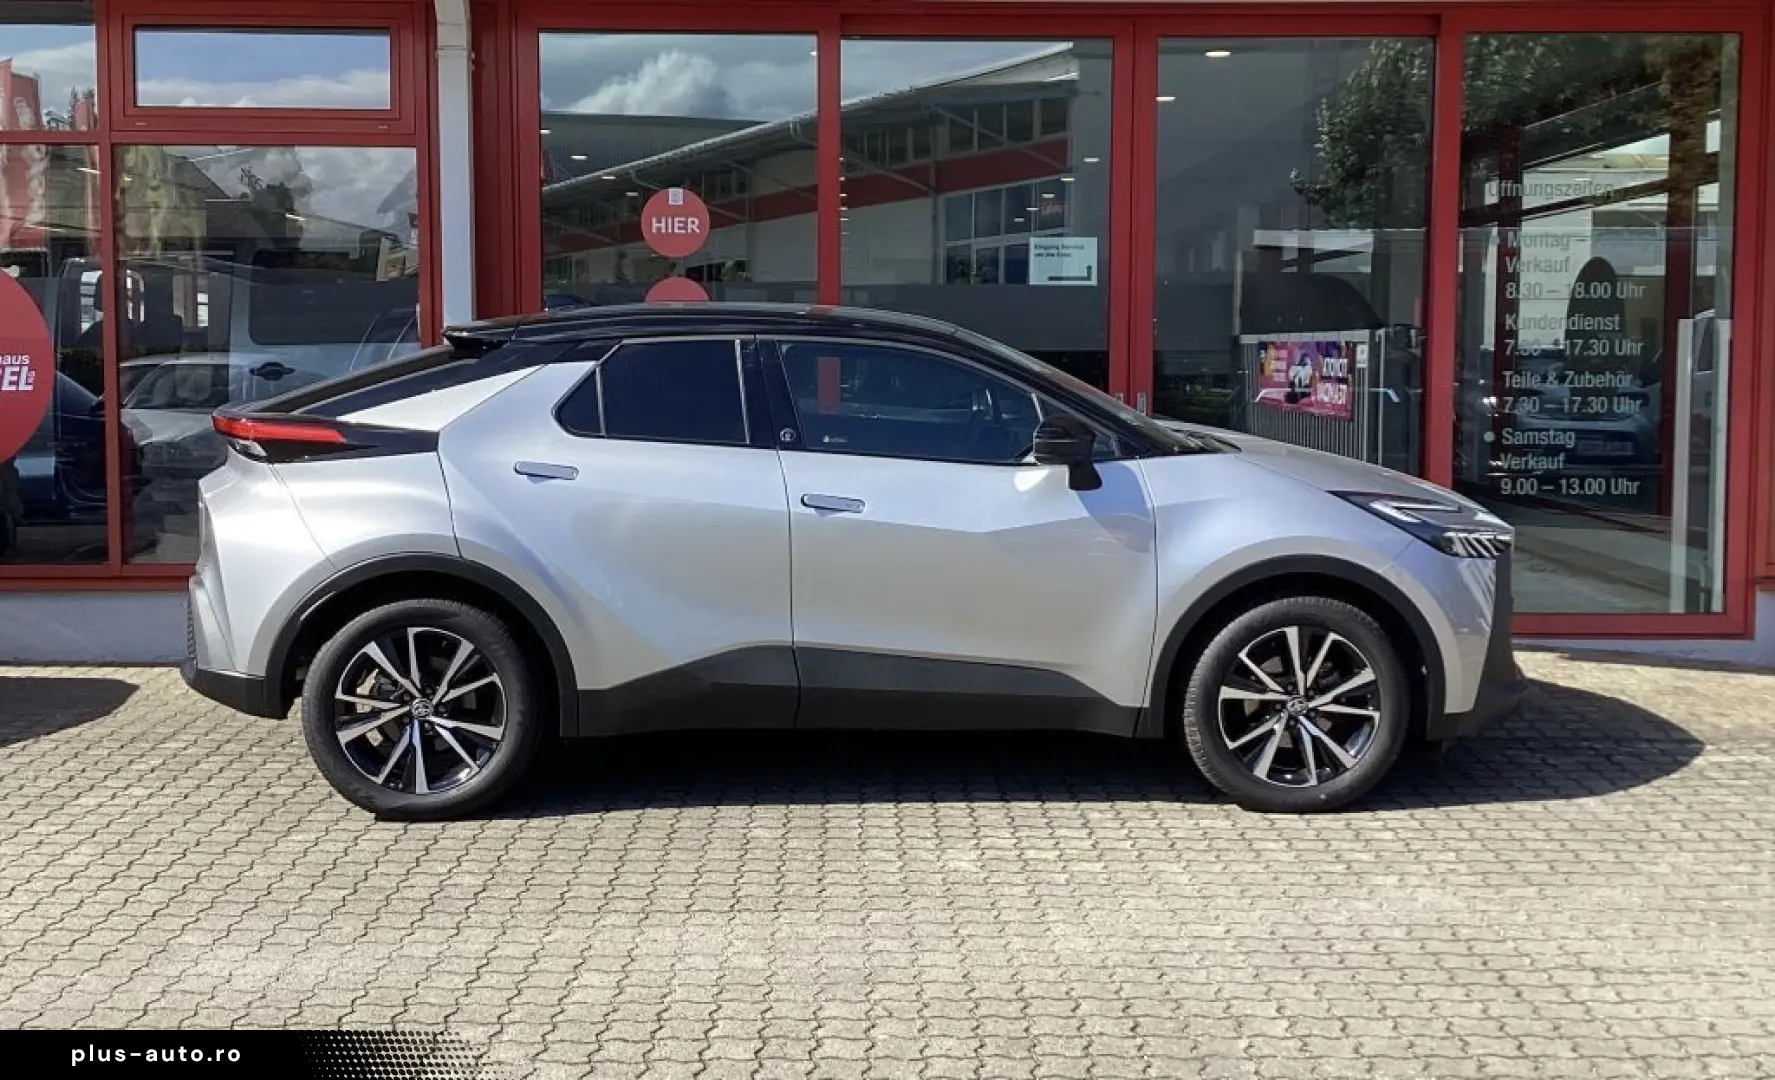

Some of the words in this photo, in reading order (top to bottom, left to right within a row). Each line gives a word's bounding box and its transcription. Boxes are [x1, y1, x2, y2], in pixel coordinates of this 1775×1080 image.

[652, 217, 700, 233] HIER
[1507, 231, 1570, 250] Montag
[1505, 255, 1571, 273] Verkauf
[1505, 282, 1542, 298] 8.30
[1616, 281, 1648, 298] Uhr
[1505, 313, 1622, 331] Kundendienst
[1565, 339, 1610, 356] 17.30
[1614, 339, 1646, 356] Uhr
[1502, 371, 1541, 388] Teile
[1564, 370, 1634, 388] Zubehör
[1503, 396, 1540, 413] 7.30
[1563, 396, 1608, 413] 17.30
[1612, 396, 1643, 413] Uhr
[1502, 428, 1576, 448] Samstag
[1501, 452, 1566, 469] Verkauf
[1500, 478, 1538, 495] 9.00
[1560, 478, 1606, 495] 13.00
[1610, 478, 1641, 495] Uhr
